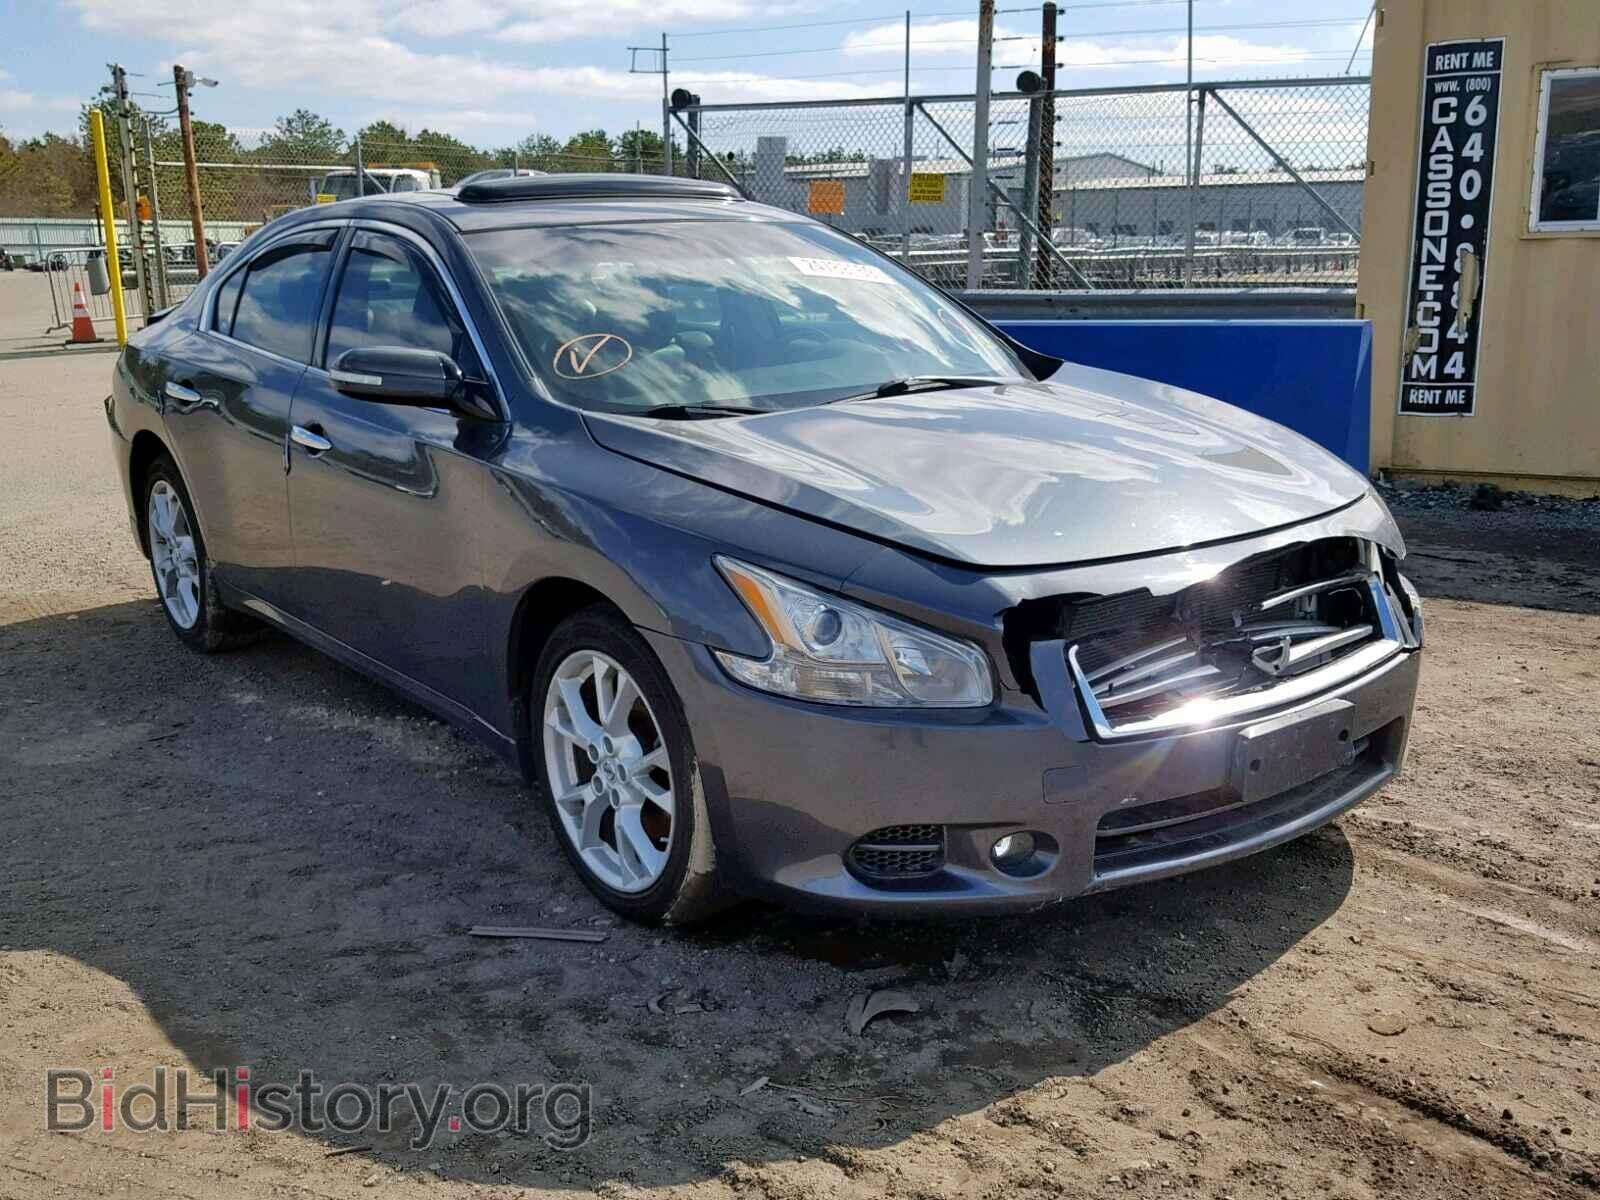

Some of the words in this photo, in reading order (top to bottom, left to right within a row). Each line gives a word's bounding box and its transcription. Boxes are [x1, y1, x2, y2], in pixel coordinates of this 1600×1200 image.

[1435, 52, 1469, 71] RENT
[1472, 51, 1495, 68] ME
[1465, 77, 1491, 93] (800)
[1411, 96, 1458, 380] CASSONE.COM
[1409, 389, 1442, 404] RENT
[1445, 389, 1466, 404] ME
